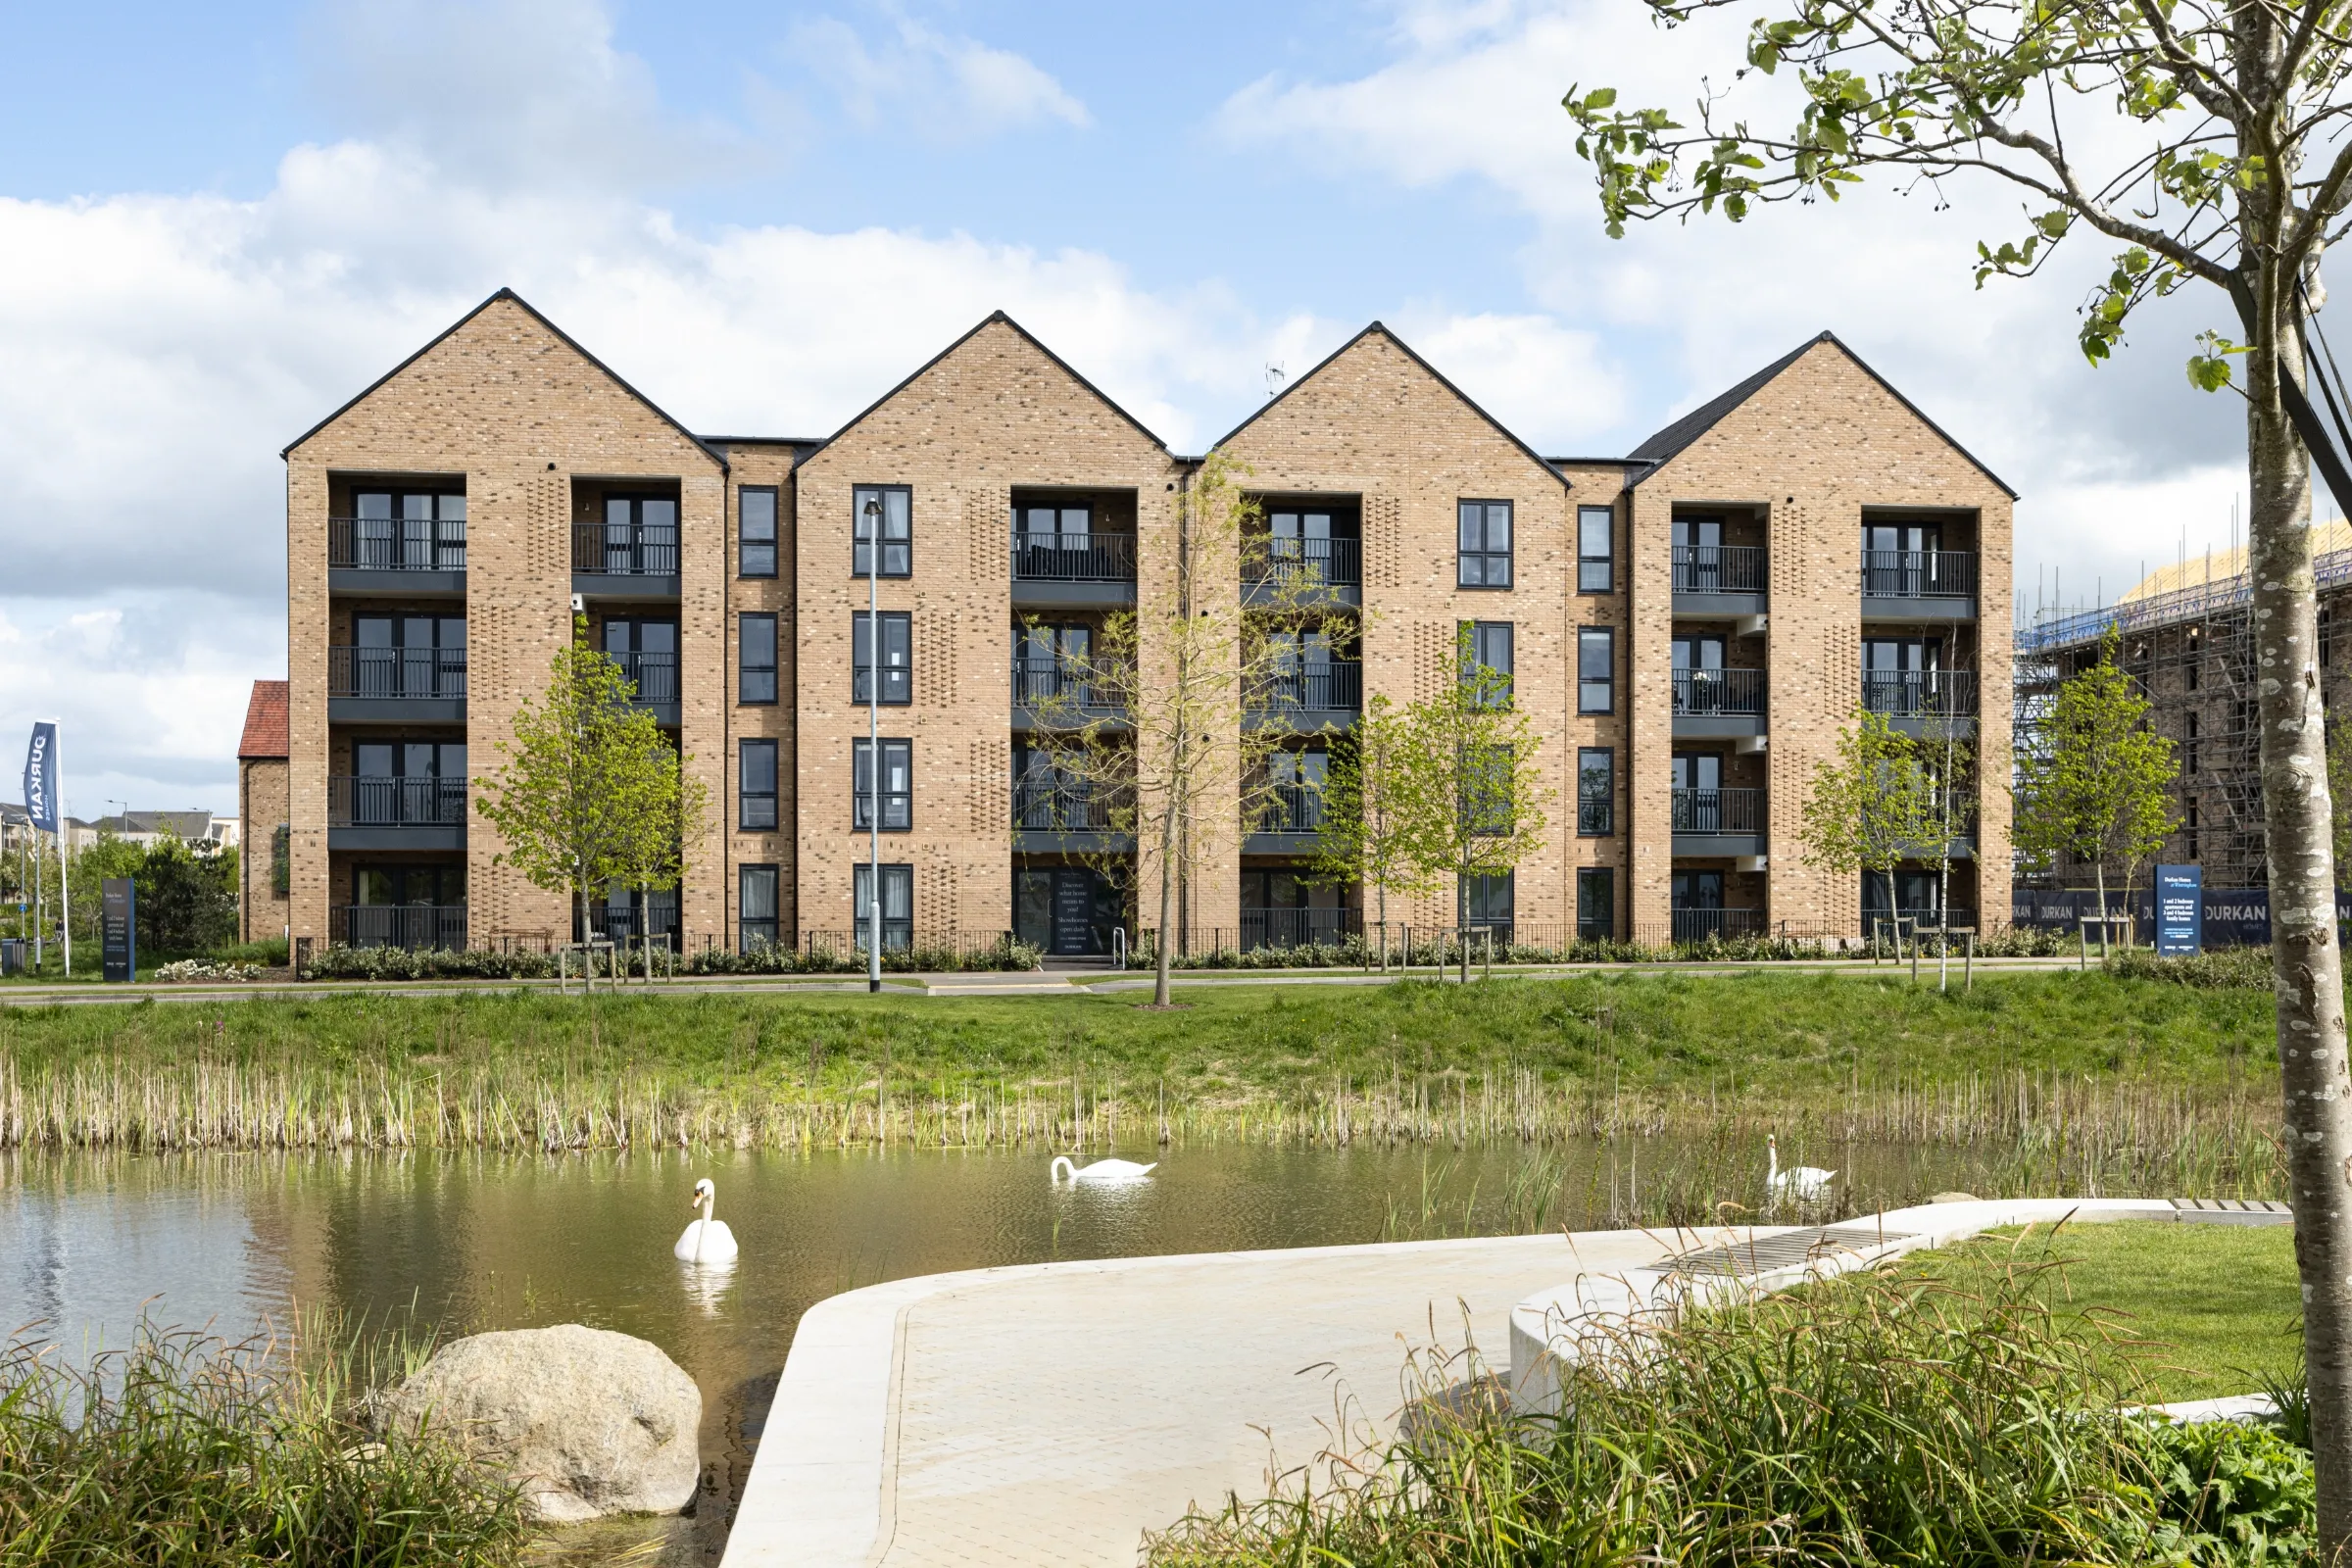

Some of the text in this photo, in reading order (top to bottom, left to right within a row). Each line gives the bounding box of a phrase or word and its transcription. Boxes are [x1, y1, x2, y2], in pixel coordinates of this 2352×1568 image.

[2041, 906, 2073, 919] DURKAN
[2082, 906, 2128, 917] DUKAN
[2204, 906, 2266, 920] DURKAN
